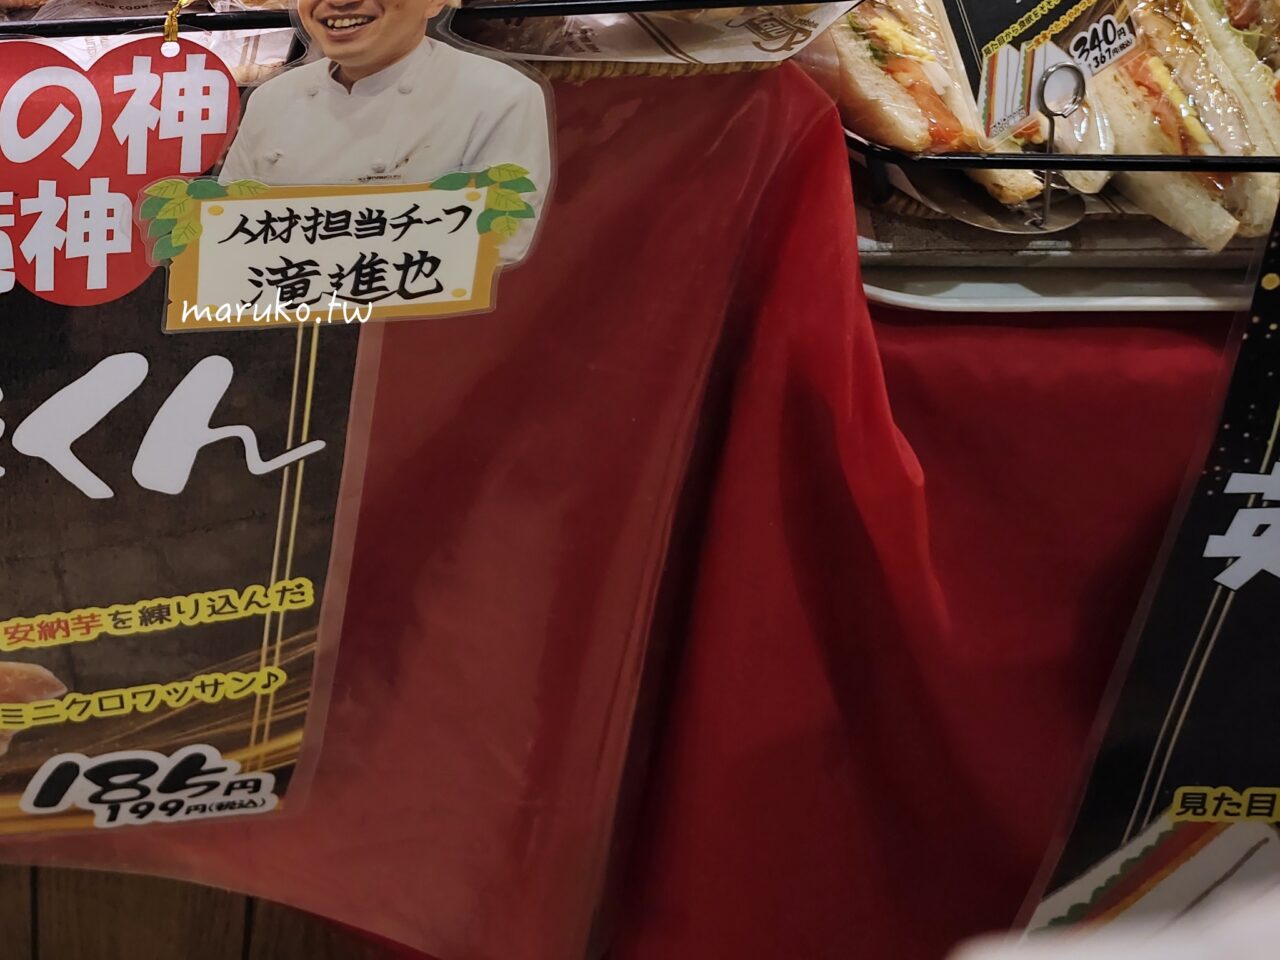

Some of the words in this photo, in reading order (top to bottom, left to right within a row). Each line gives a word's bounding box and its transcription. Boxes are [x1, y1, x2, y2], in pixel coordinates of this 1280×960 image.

[1073, 18, 1128, 62] 340円
[217, 203, 473, 245] 人材担当チーフ
[33, 750, 264, 809] 185円
[107, 793, 268, 824] 199円(税込)
[1175, 792, 1277, 818] 見た目
